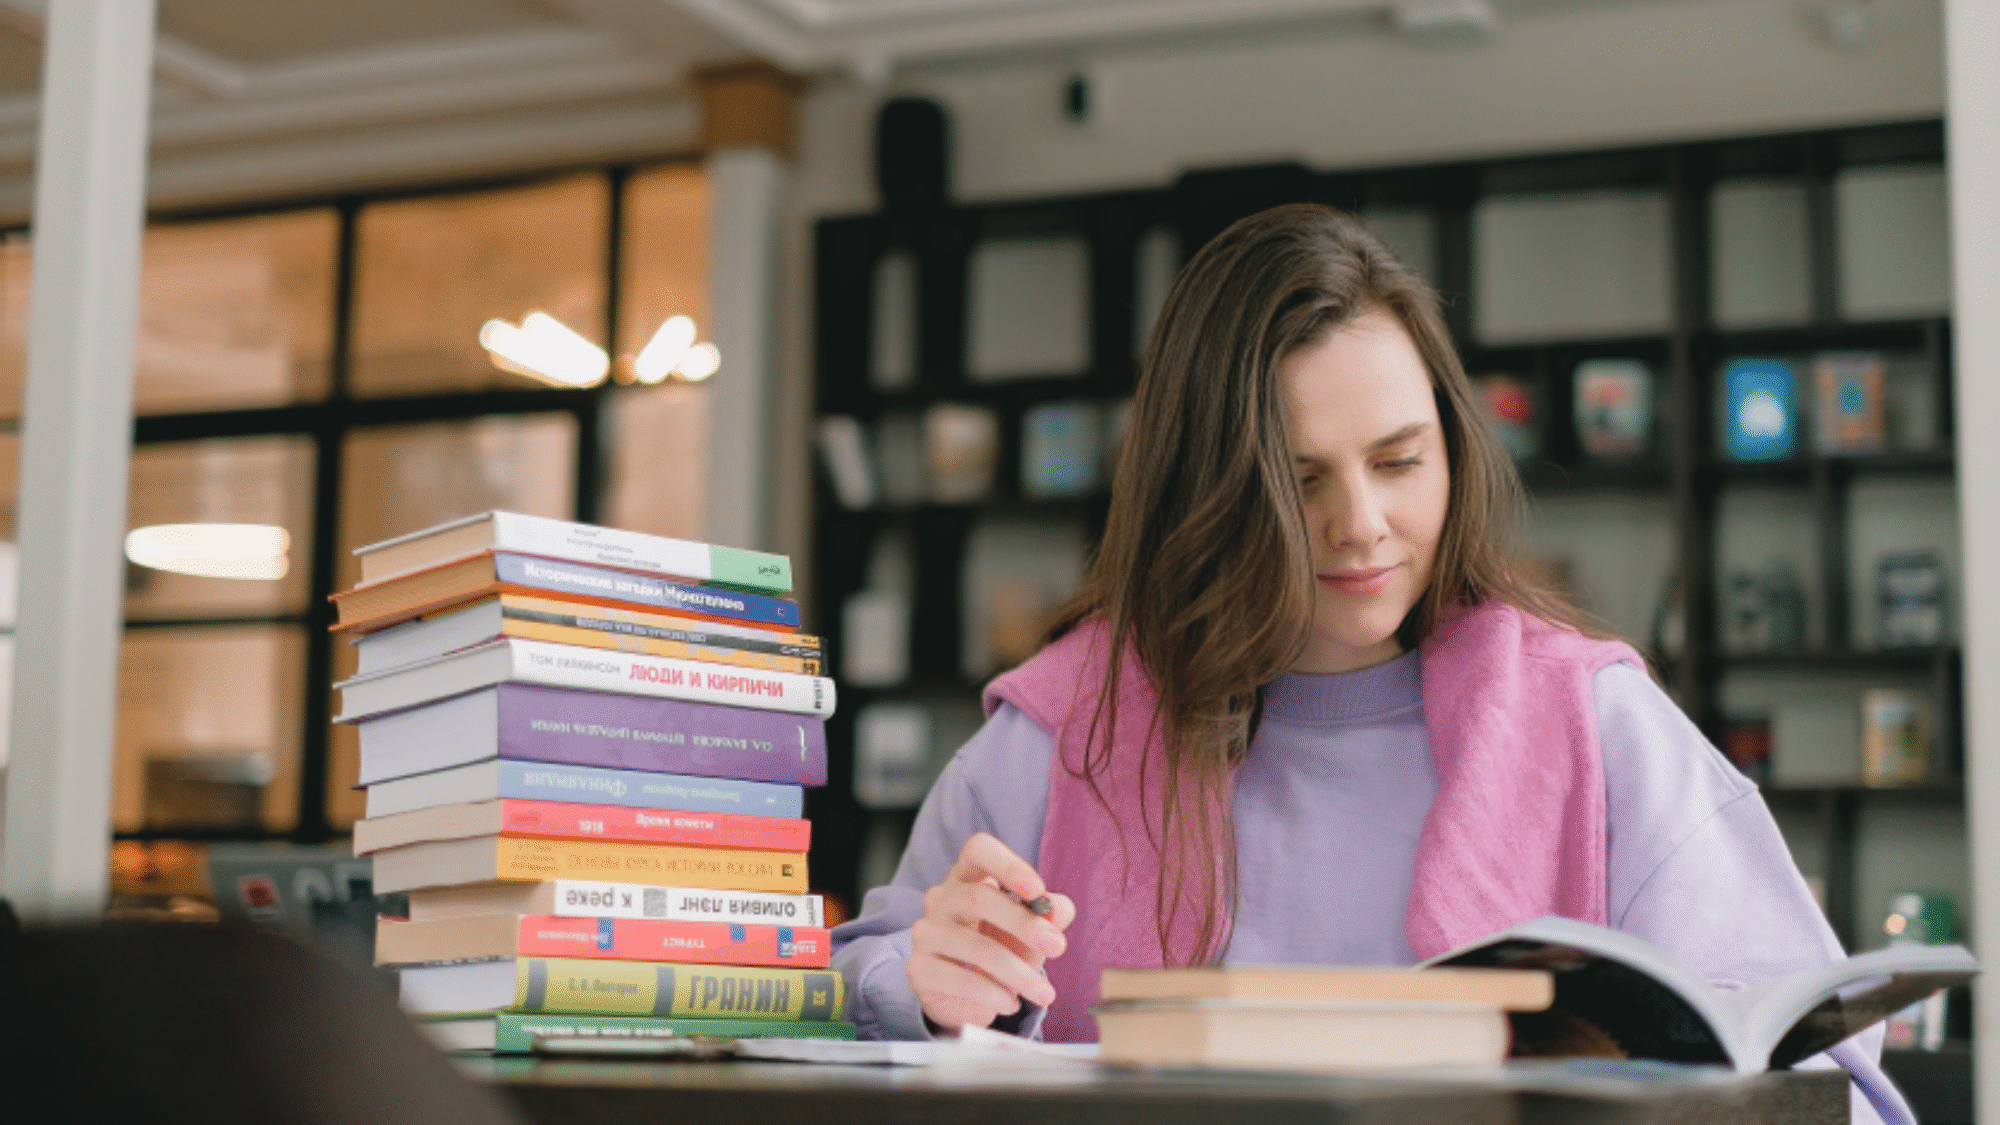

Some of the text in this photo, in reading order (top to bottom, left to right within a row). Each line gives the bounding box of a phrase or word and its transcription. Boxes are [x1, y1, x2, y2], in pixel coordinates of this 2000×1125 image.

[629, 663, 782, 697] ЛЮДИ И КИРПИЧИ
[578, 819, 603, 832] 1918
[625, 856, 661, 872] КУРСА
[663, 936, 705, 948] ТУРИСТ
[689, 976, 789, 1011] ГРАНИН
